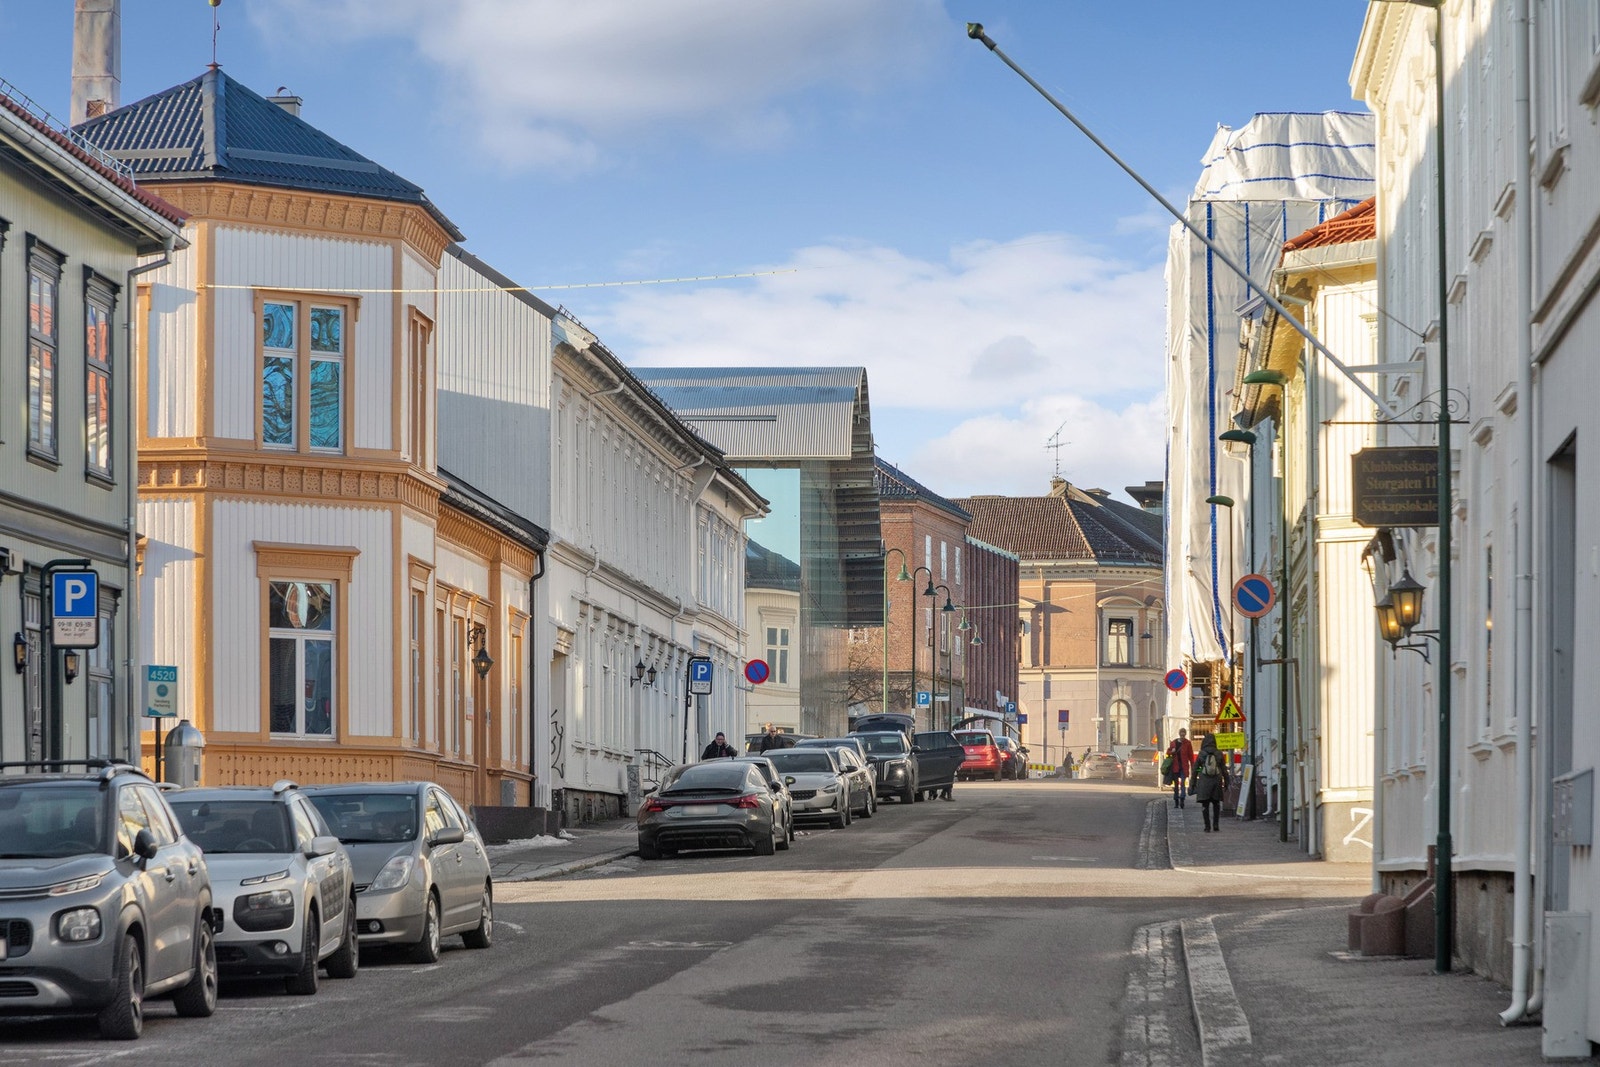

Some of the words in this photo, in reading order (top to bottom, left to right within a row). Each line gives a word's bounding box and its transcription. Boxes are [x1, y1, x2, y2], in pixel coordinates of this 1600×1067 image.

[1361, 460, 1438, 474] Klubbselskape
[1366, 476, 1422, 493] Storgaten
[1361, 500, 1438, 514] Selskapslokale
[65, 579, 87, 613] P
[150, 670, 176, 681] 4520
[697, 664, 708, 679] P
[919, 693, 927, 704] P
[1008, 703, 1015, 712] P
